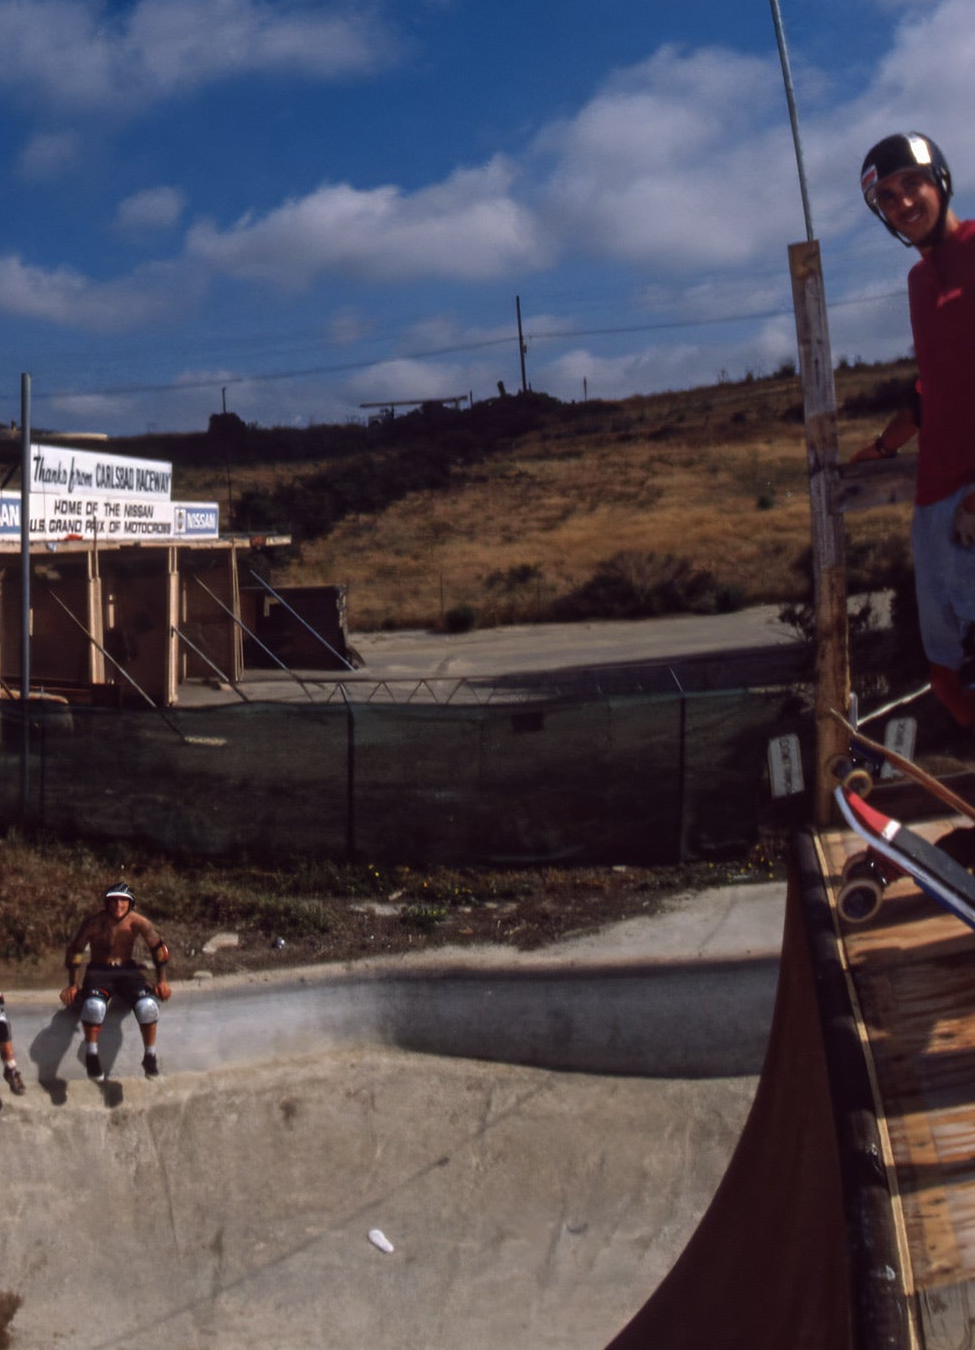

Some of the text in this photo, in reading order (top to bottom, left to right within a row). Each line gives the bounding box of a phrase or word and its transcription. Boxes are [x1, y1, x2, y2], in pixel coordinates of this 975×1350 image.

[68, 457, 93, 493] from
[95, 463, 134, 491] CARLSBAD
[135, 467, 171, 494] RACEWAY
[54, 499, 154, 518] HOME OF THE NISSAN
[48, 519, 83, 534] GRAND
[85, 519, 106, 534] PRIX
[109, 521, 121, 534] OF
[124, 521, 172, 535] MOTOCROSS
[187, 512, 216, 529] NISSAN
